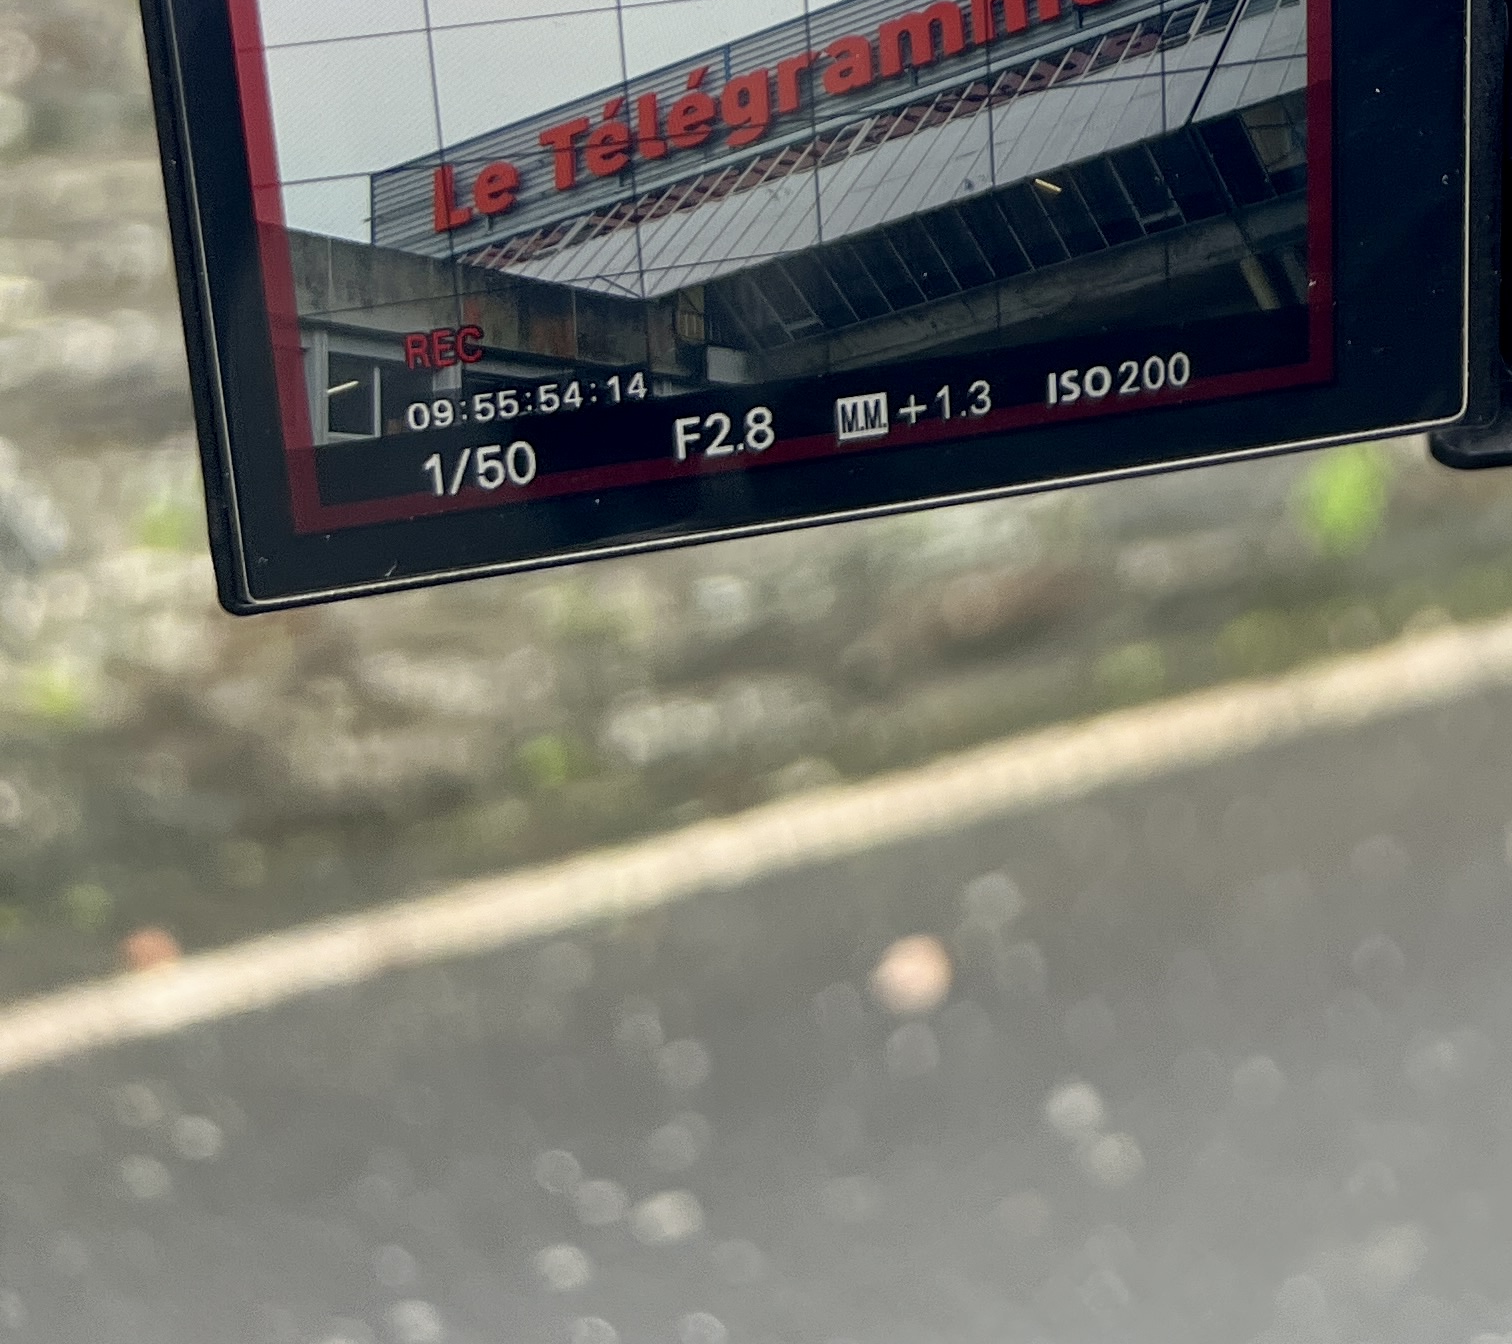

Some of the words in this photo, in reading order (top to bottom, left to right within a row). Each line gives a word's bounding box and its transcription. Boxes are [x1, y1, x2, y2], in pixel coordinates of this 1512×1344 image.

[431, 160, 521, 233] Le
[404, 324, 485, 370] REC
[407, 371, 650, 431] 09:55:54:14
[899, 378, 993, 425] +1.3
[672, 405, 776, 462] F2.8
[422, 440, 538, 497] 1/50
